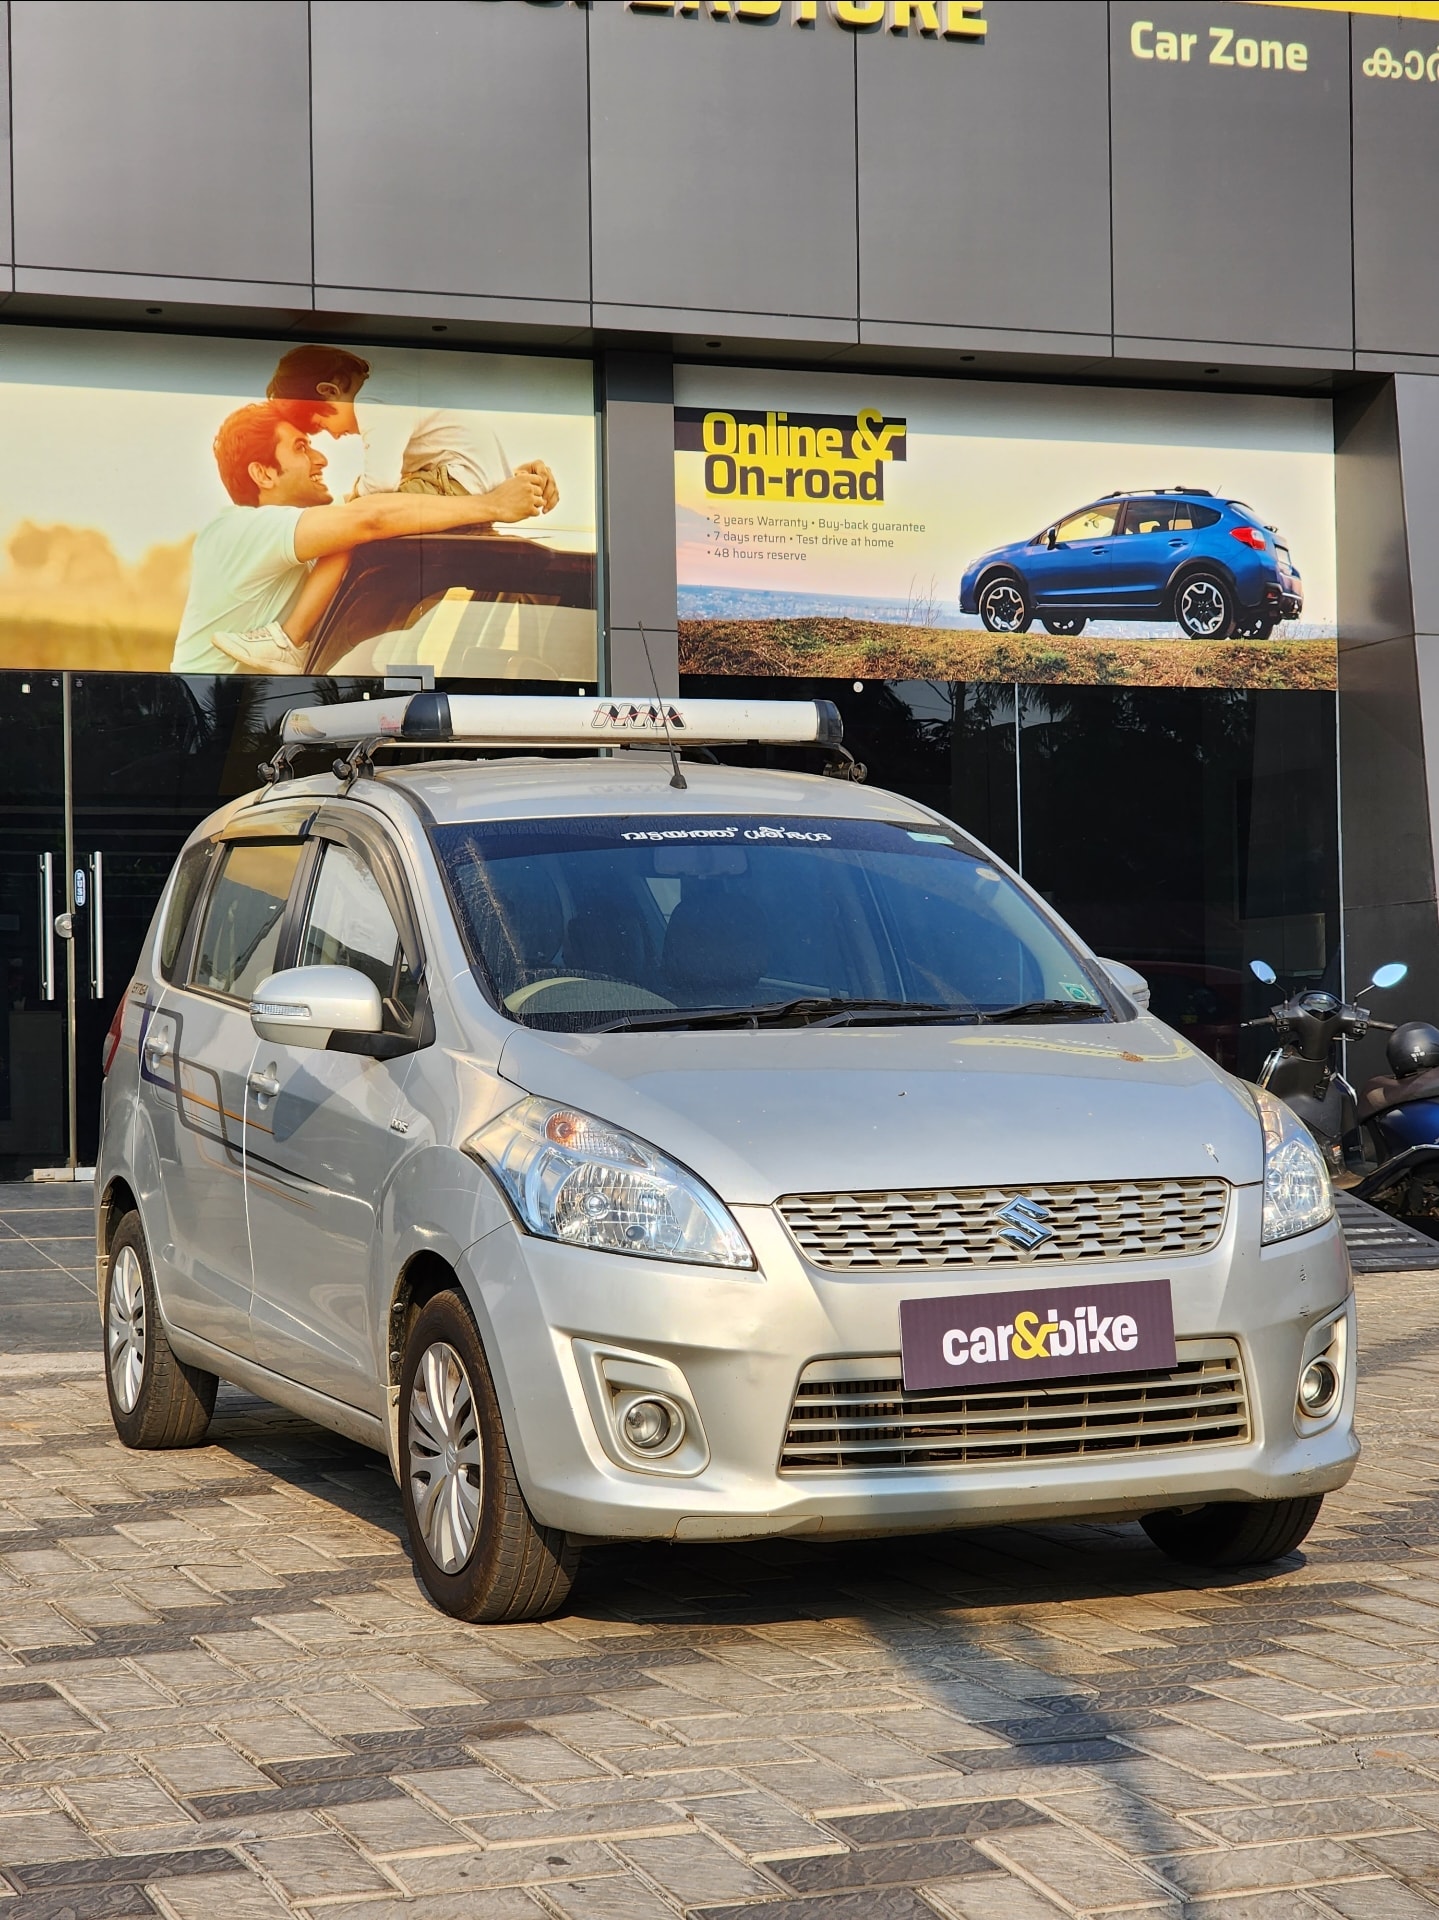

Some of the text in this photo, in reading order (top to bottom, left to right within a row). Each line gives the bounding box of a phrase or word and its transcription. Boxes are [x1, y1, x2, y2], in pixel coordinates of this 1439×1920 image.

[1129, 20, 1308, 72] Car Zone
[702, 408, 907, 461] Online &
[704, 454, 884, 501] On-road
[713, 514, 926, 533] 2 years Warranty Buy-back guarantee
[713, 530, 894, 548] 7 days return Test drive at home
[714, 547, 807, 561] 48 hours reserve
[942, 1305, 1138, 1366] car&bike
